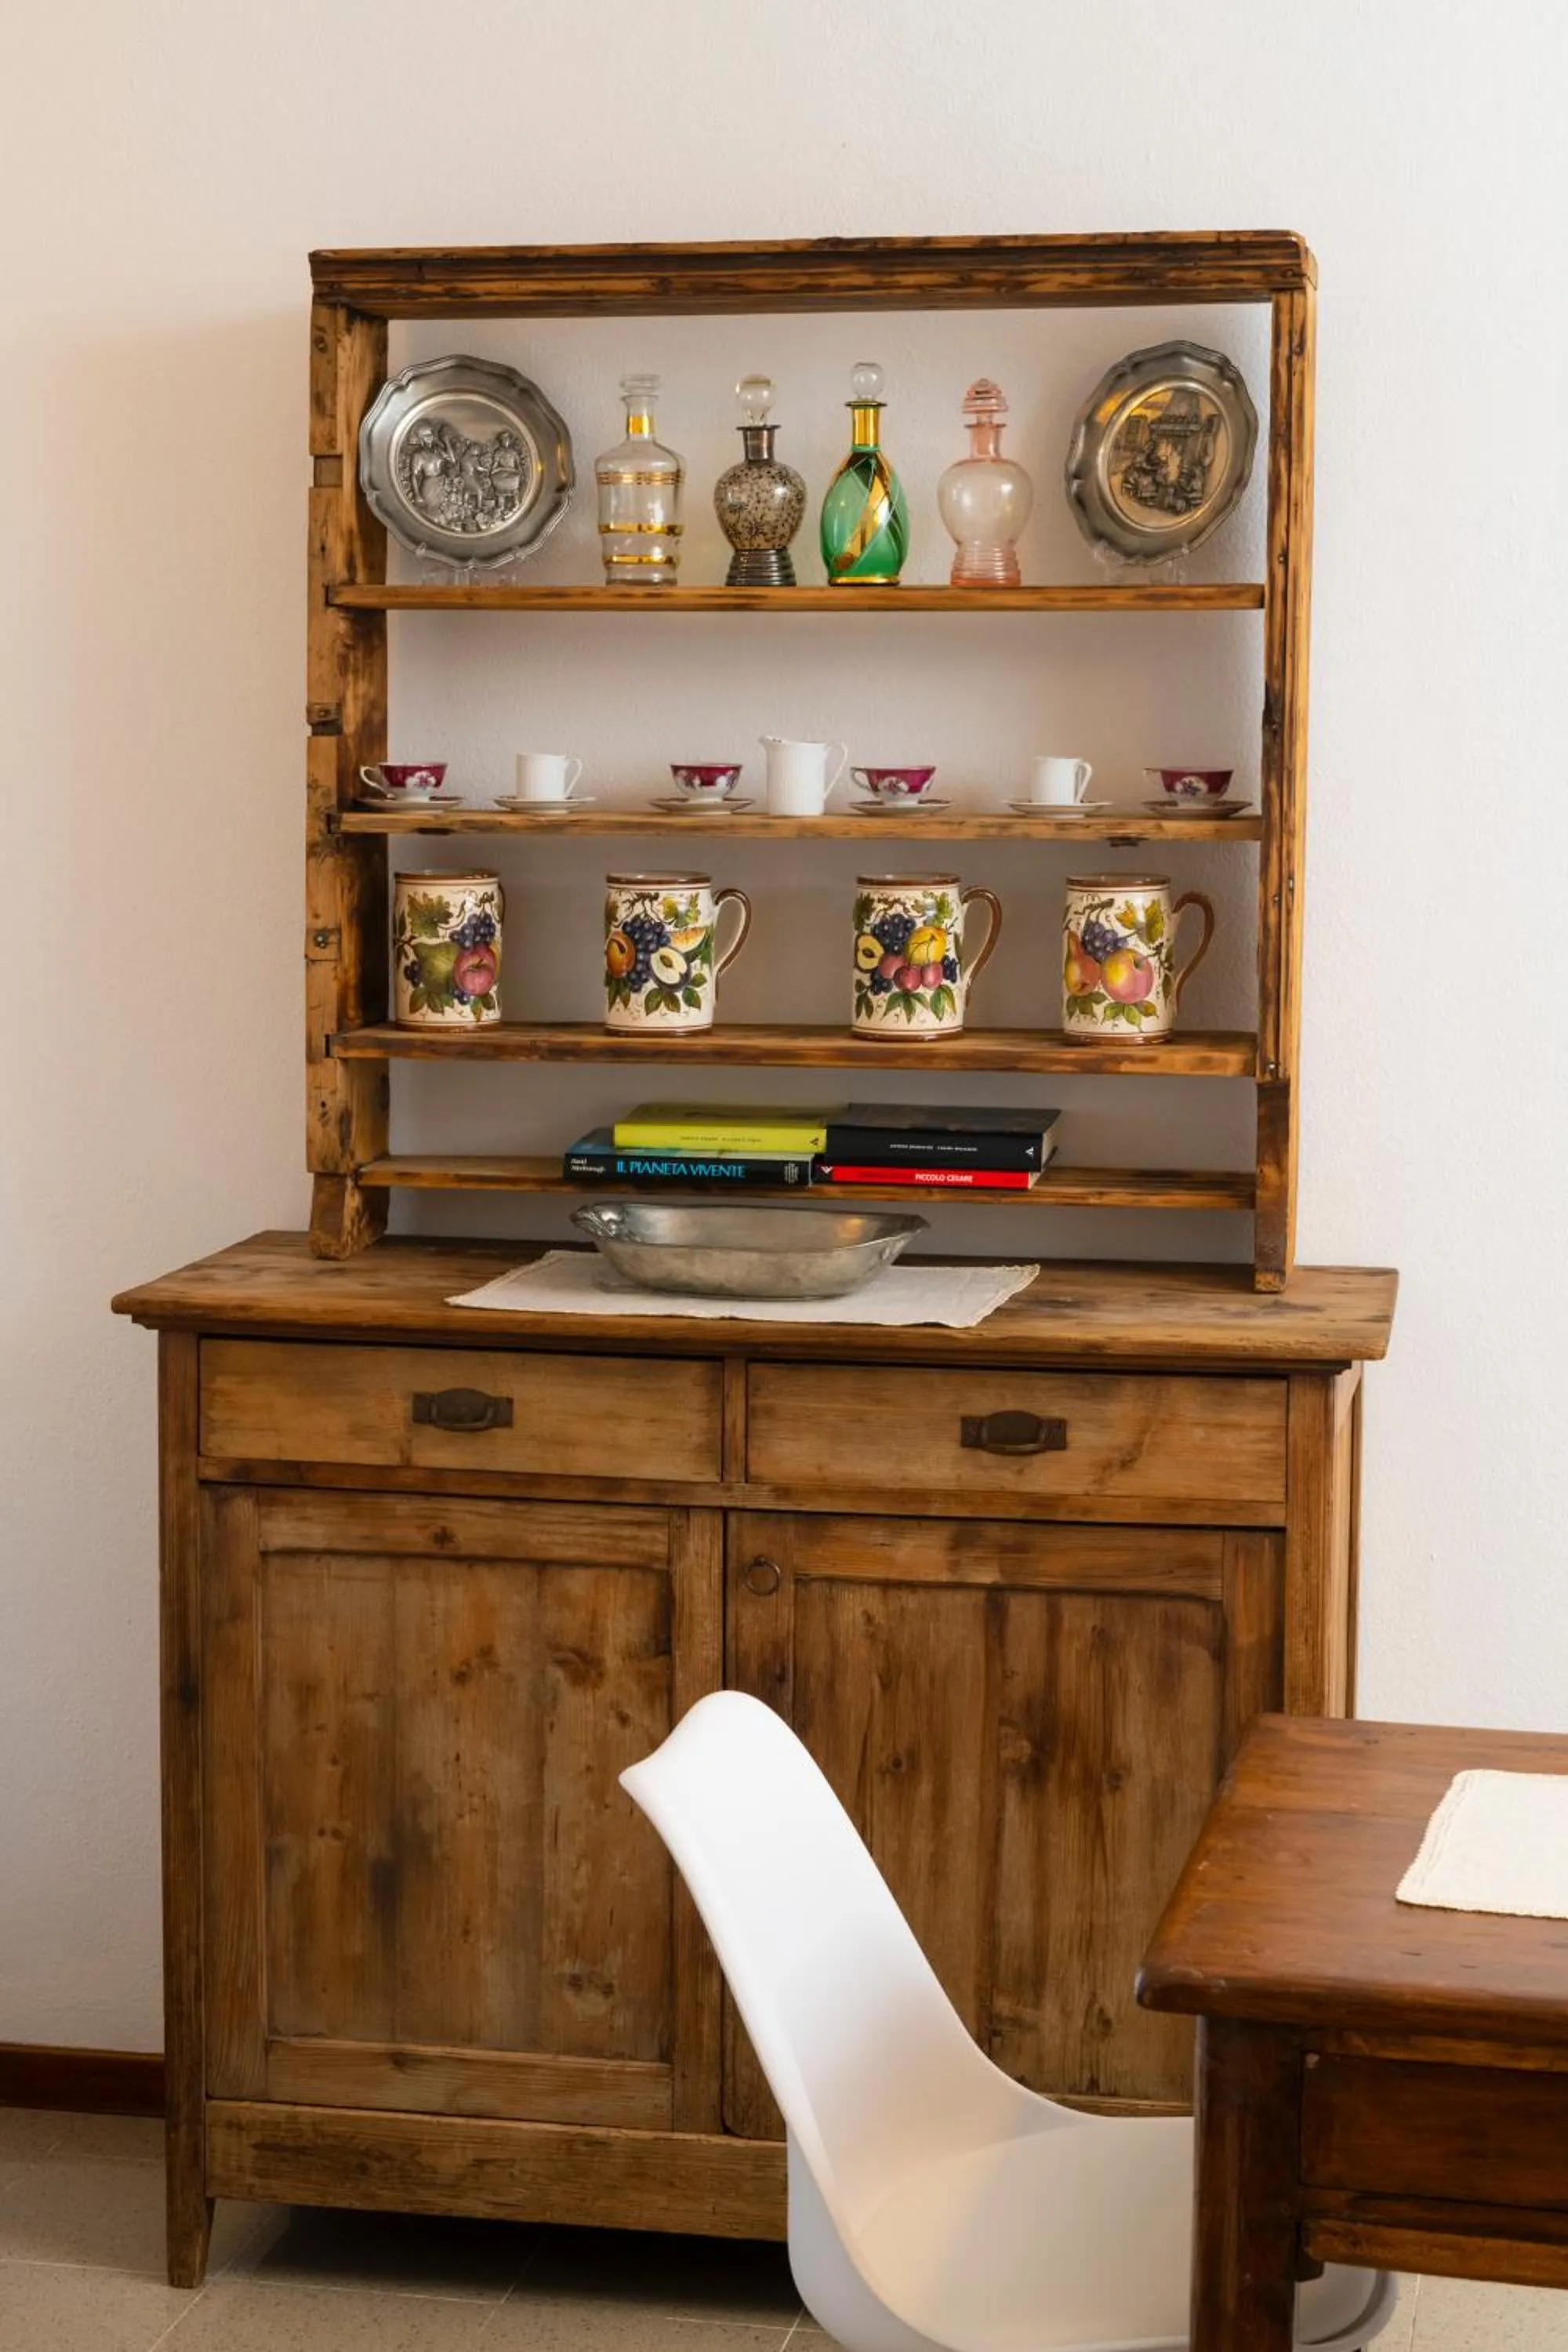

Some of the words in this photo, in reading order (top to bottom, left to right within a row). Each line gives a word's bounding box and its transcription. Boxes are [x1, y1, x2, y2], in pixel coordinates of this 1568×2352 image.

[616, 1160, 627, 1174] IL
[630, 1160, 688, 1175] PIANETA
[689, 1163, 746, 1178] VIVENTE
[915, 1173, 946, 1182] PICCOLO
[946, 1174, 974, 1183] CESARE
